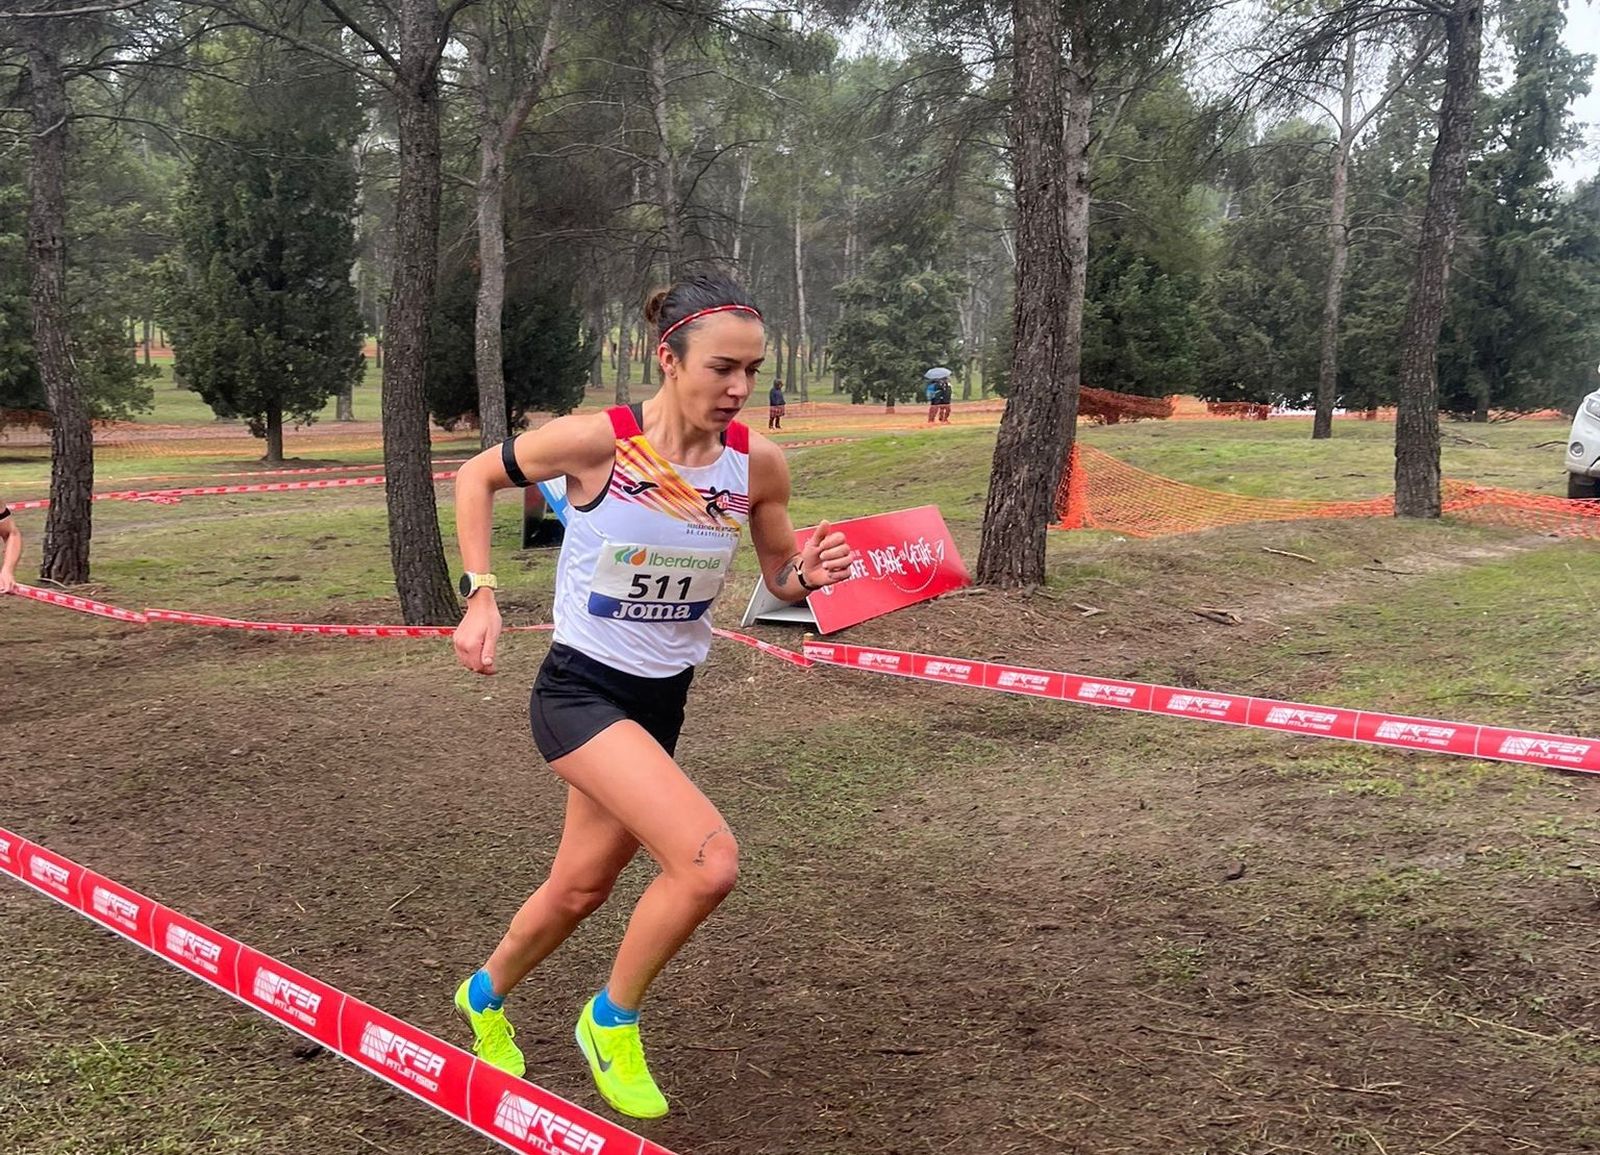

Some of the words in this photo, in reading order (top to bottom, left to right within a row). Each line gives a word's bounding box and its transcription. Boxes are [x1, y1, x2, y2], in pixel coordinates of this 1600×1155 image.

[648, 552, 721, 569] Iberdrola
[849, 559, 869, 580] AFE
[628, 574, 692, 600] 511
[1403, 724, 1457, 738] RFEA
[1531, 739, 1592, 755] RFEA
[185, 931, 223, 962] RFEA
[276, 976, 322, 1013] RFEA
[388, 1033, 447, 1077] RFEA
[530, 1106, 607, 1155] RFEA
